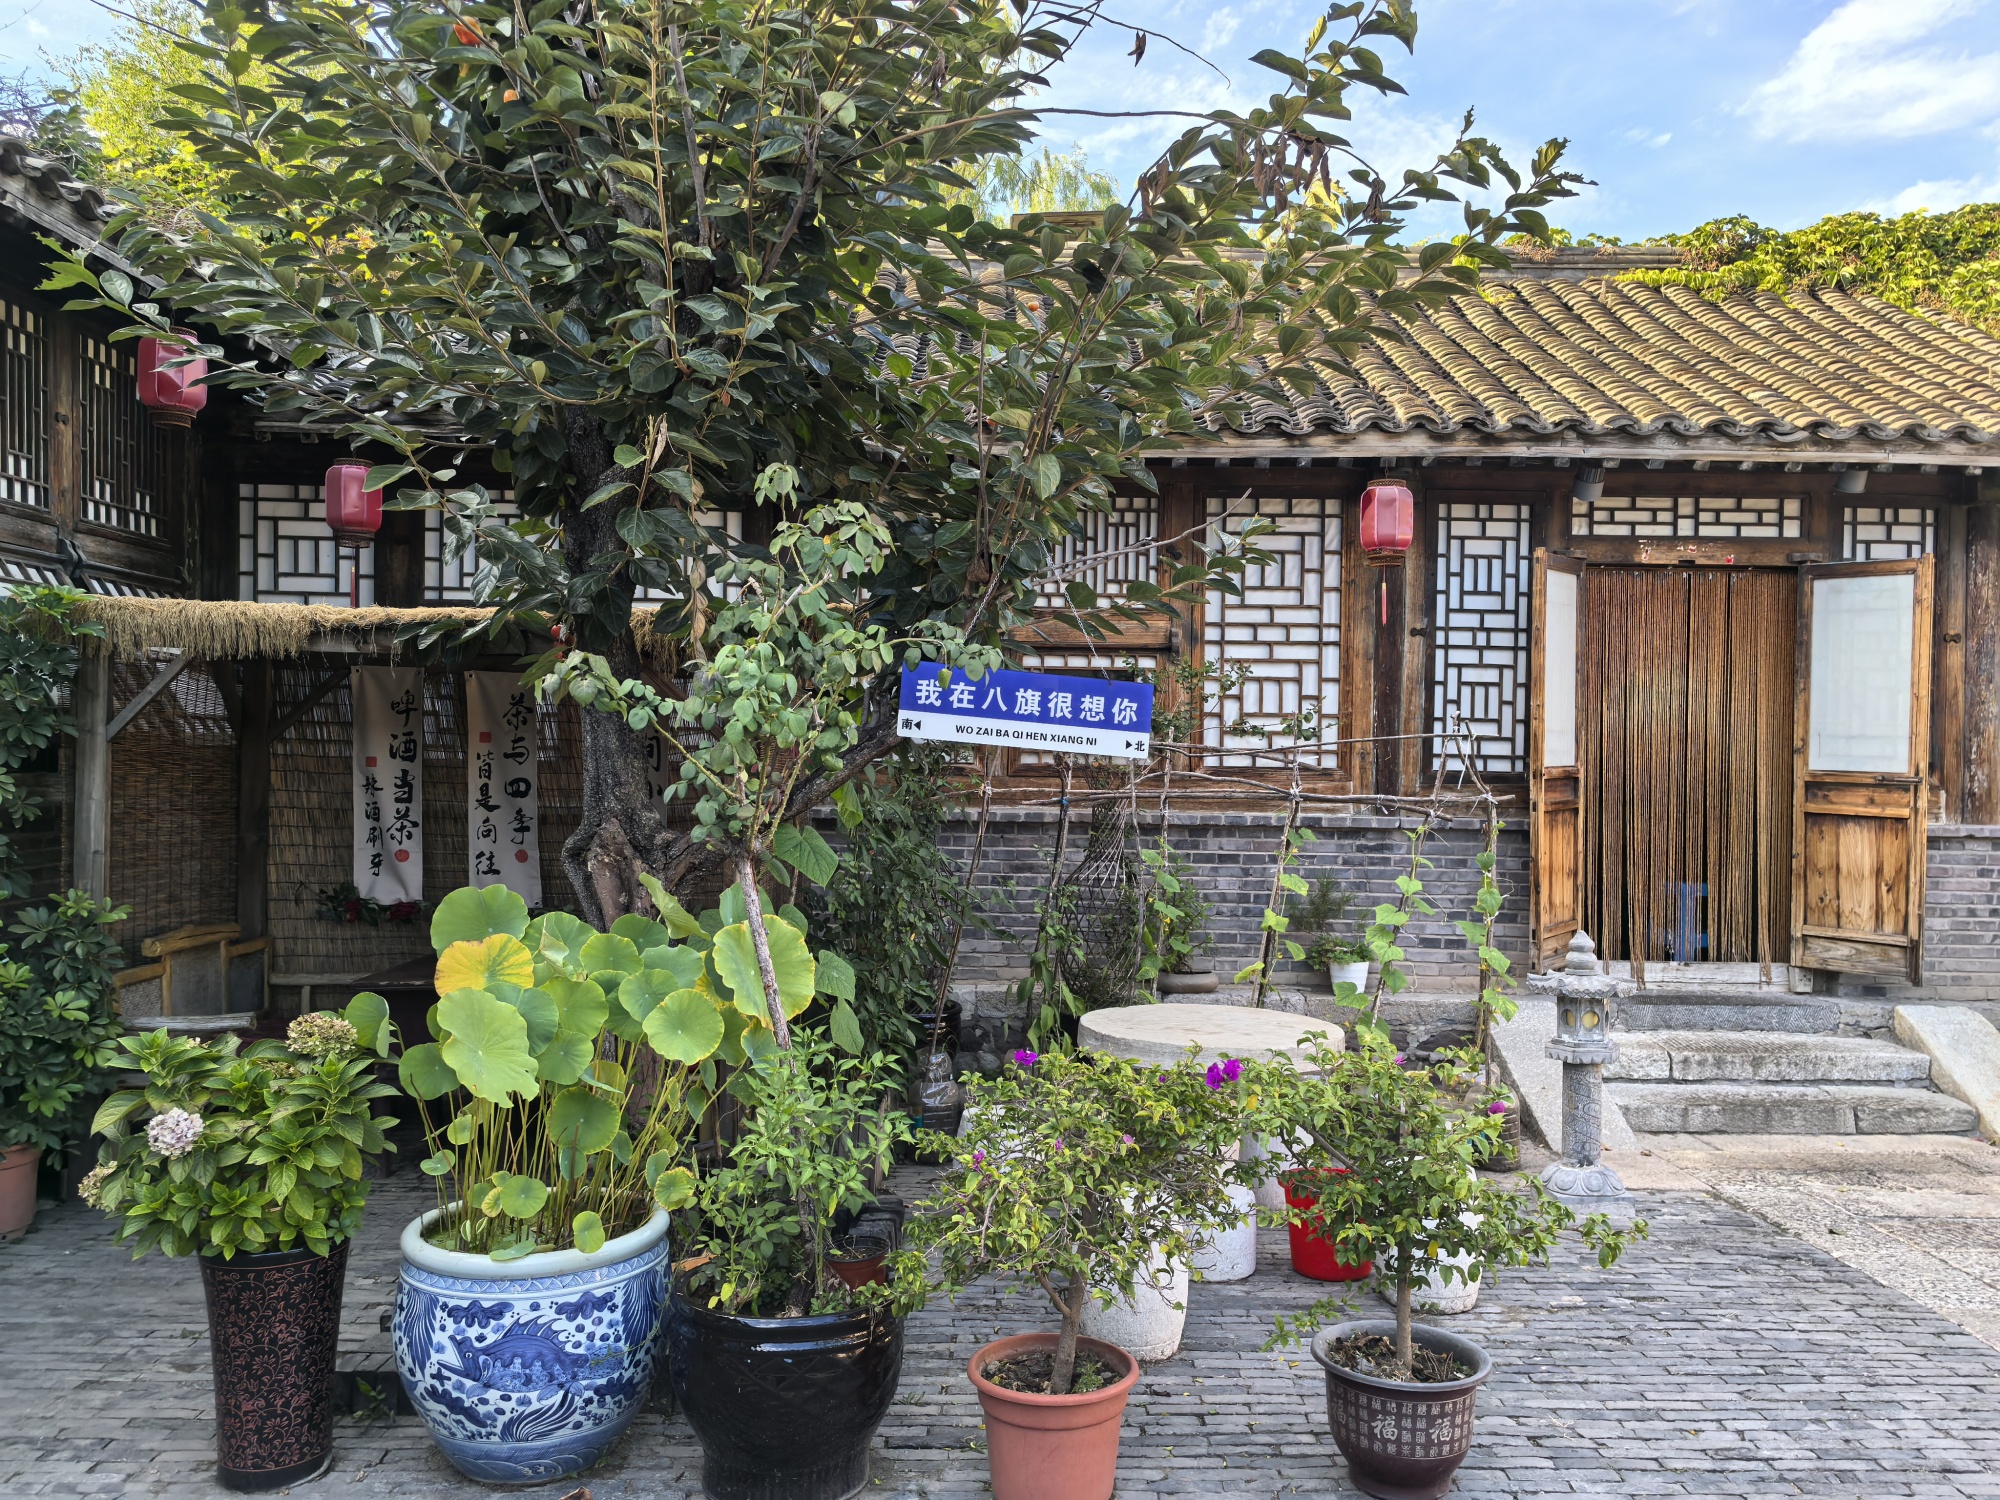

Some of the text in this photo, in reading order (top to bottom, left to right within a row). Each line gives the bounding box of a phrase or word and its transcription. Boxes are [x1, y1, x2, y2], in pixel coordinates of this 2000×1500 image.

[915, 678, 1138, 726] 我在八旗很想你
[901, 717, 913, 731] 南
[955, 724, 1097, 746] WO ZAI BA QI HEN XIANG NI
[1134, 740, 1146, 752] 北
[386, 688, 420, 845] 啤酒当茶
[502, 691, 534, 846] 茶与四季
[475, 750, 502, 877] 皆是向往
[1371, 1414, 1398, 1441] 福
[1429, 1416, 1453, 1443] 福
